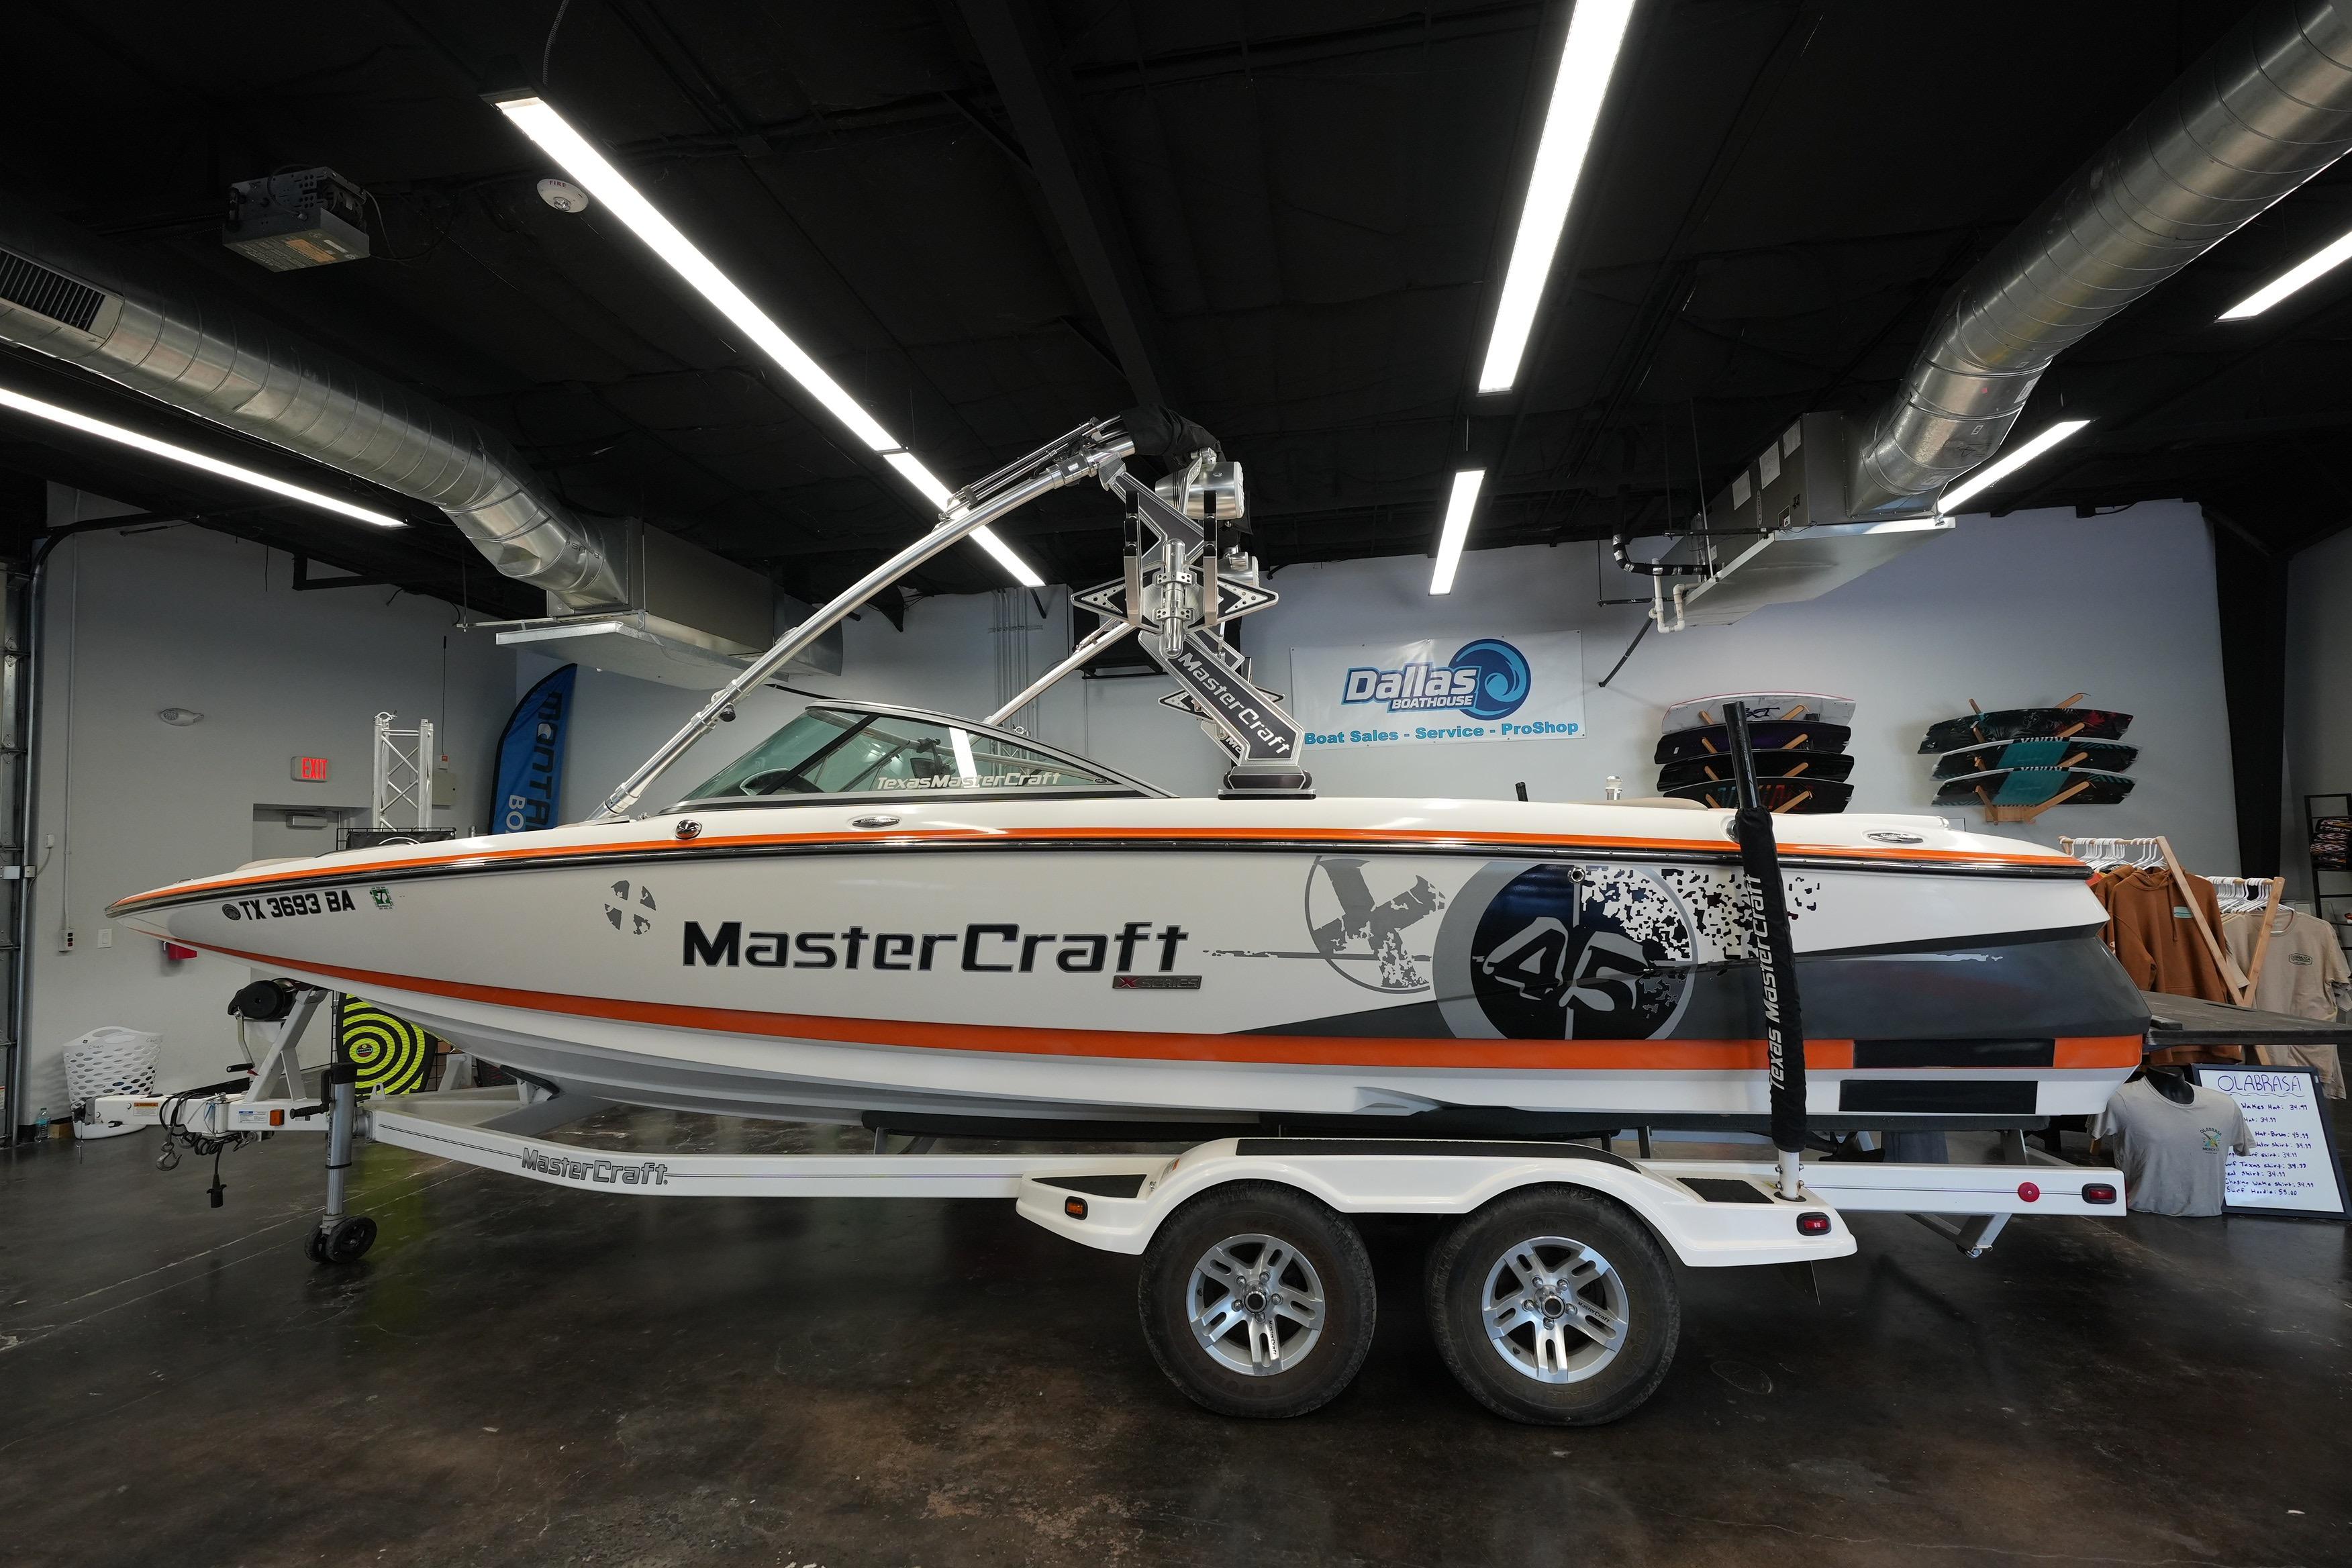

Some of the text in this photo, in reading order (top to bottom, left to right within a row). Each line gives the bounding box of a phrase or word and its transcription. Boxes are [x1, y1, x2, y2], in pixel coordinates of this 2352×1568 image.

[549, 180, 567, 188] FIRE
[1345, 665, 1477, 701] Dallas
[1178, 652, 1290, 753] MasterCraft
[1391, 695, 1473, 709] BOATHOUSE
[1304, 731, 1344, 745] Boat
[1350, 729, 1400, 743] Sales
[1415, 725, 1483, 739] Service
[1501, 721, 1579, 736] ProShop
[301, 757, 328, 780] EXIT
[505, 794, 526, 833] BO
[238, 899, 266, 921] TX
[267, 893, 322, 918] 3693
[324, 889, 356, 912] BA
[682, 920, 1189, 973] MasterCraft
[1745, 873, 1785, 1091] Texas MasterCraft
[2218, 1074, 2302, 1091] OLABRASA
[521, 1146, 667, 1185] MasterCraft
[1578, 1301, 1610, 1322] MasterCraft
